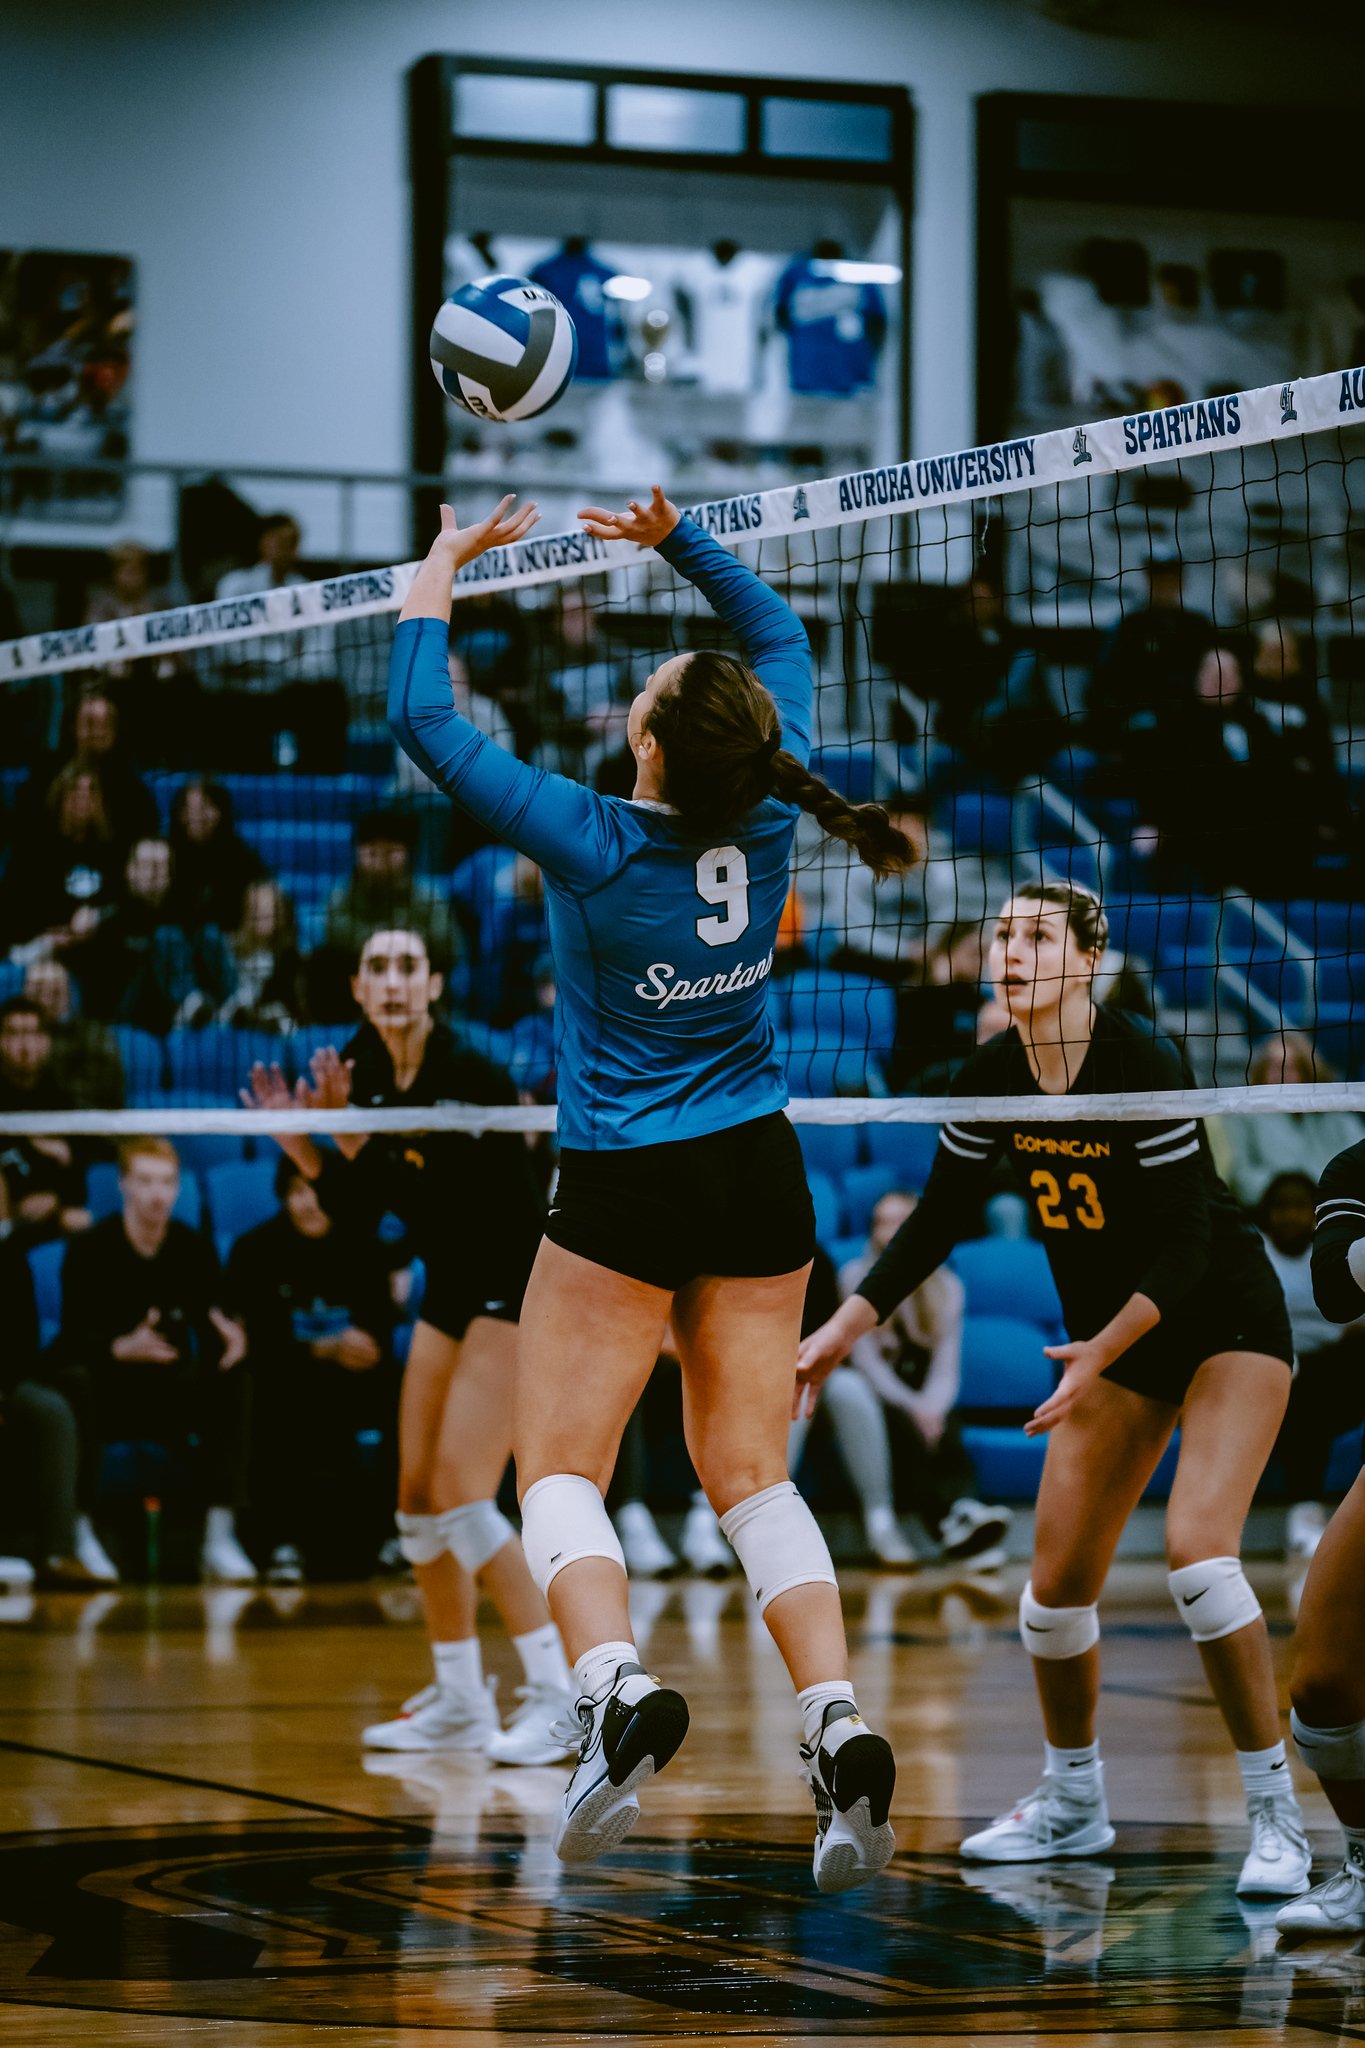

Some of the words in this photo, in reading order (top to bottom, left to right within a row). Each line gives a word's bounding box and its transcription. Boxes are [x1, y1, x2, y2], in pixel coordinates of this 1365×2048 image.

[839, 465, 914, 512] AURORA
[915, 438, 1036, 497] UNIVERSITY
[1123, 394, 1241, 455] SPARTANS
[696, 845, 750, 947] 9
[1013, 1132, 1111, 1158] DOMINICAN
[1029, 1169, 1106, 1230] 23
